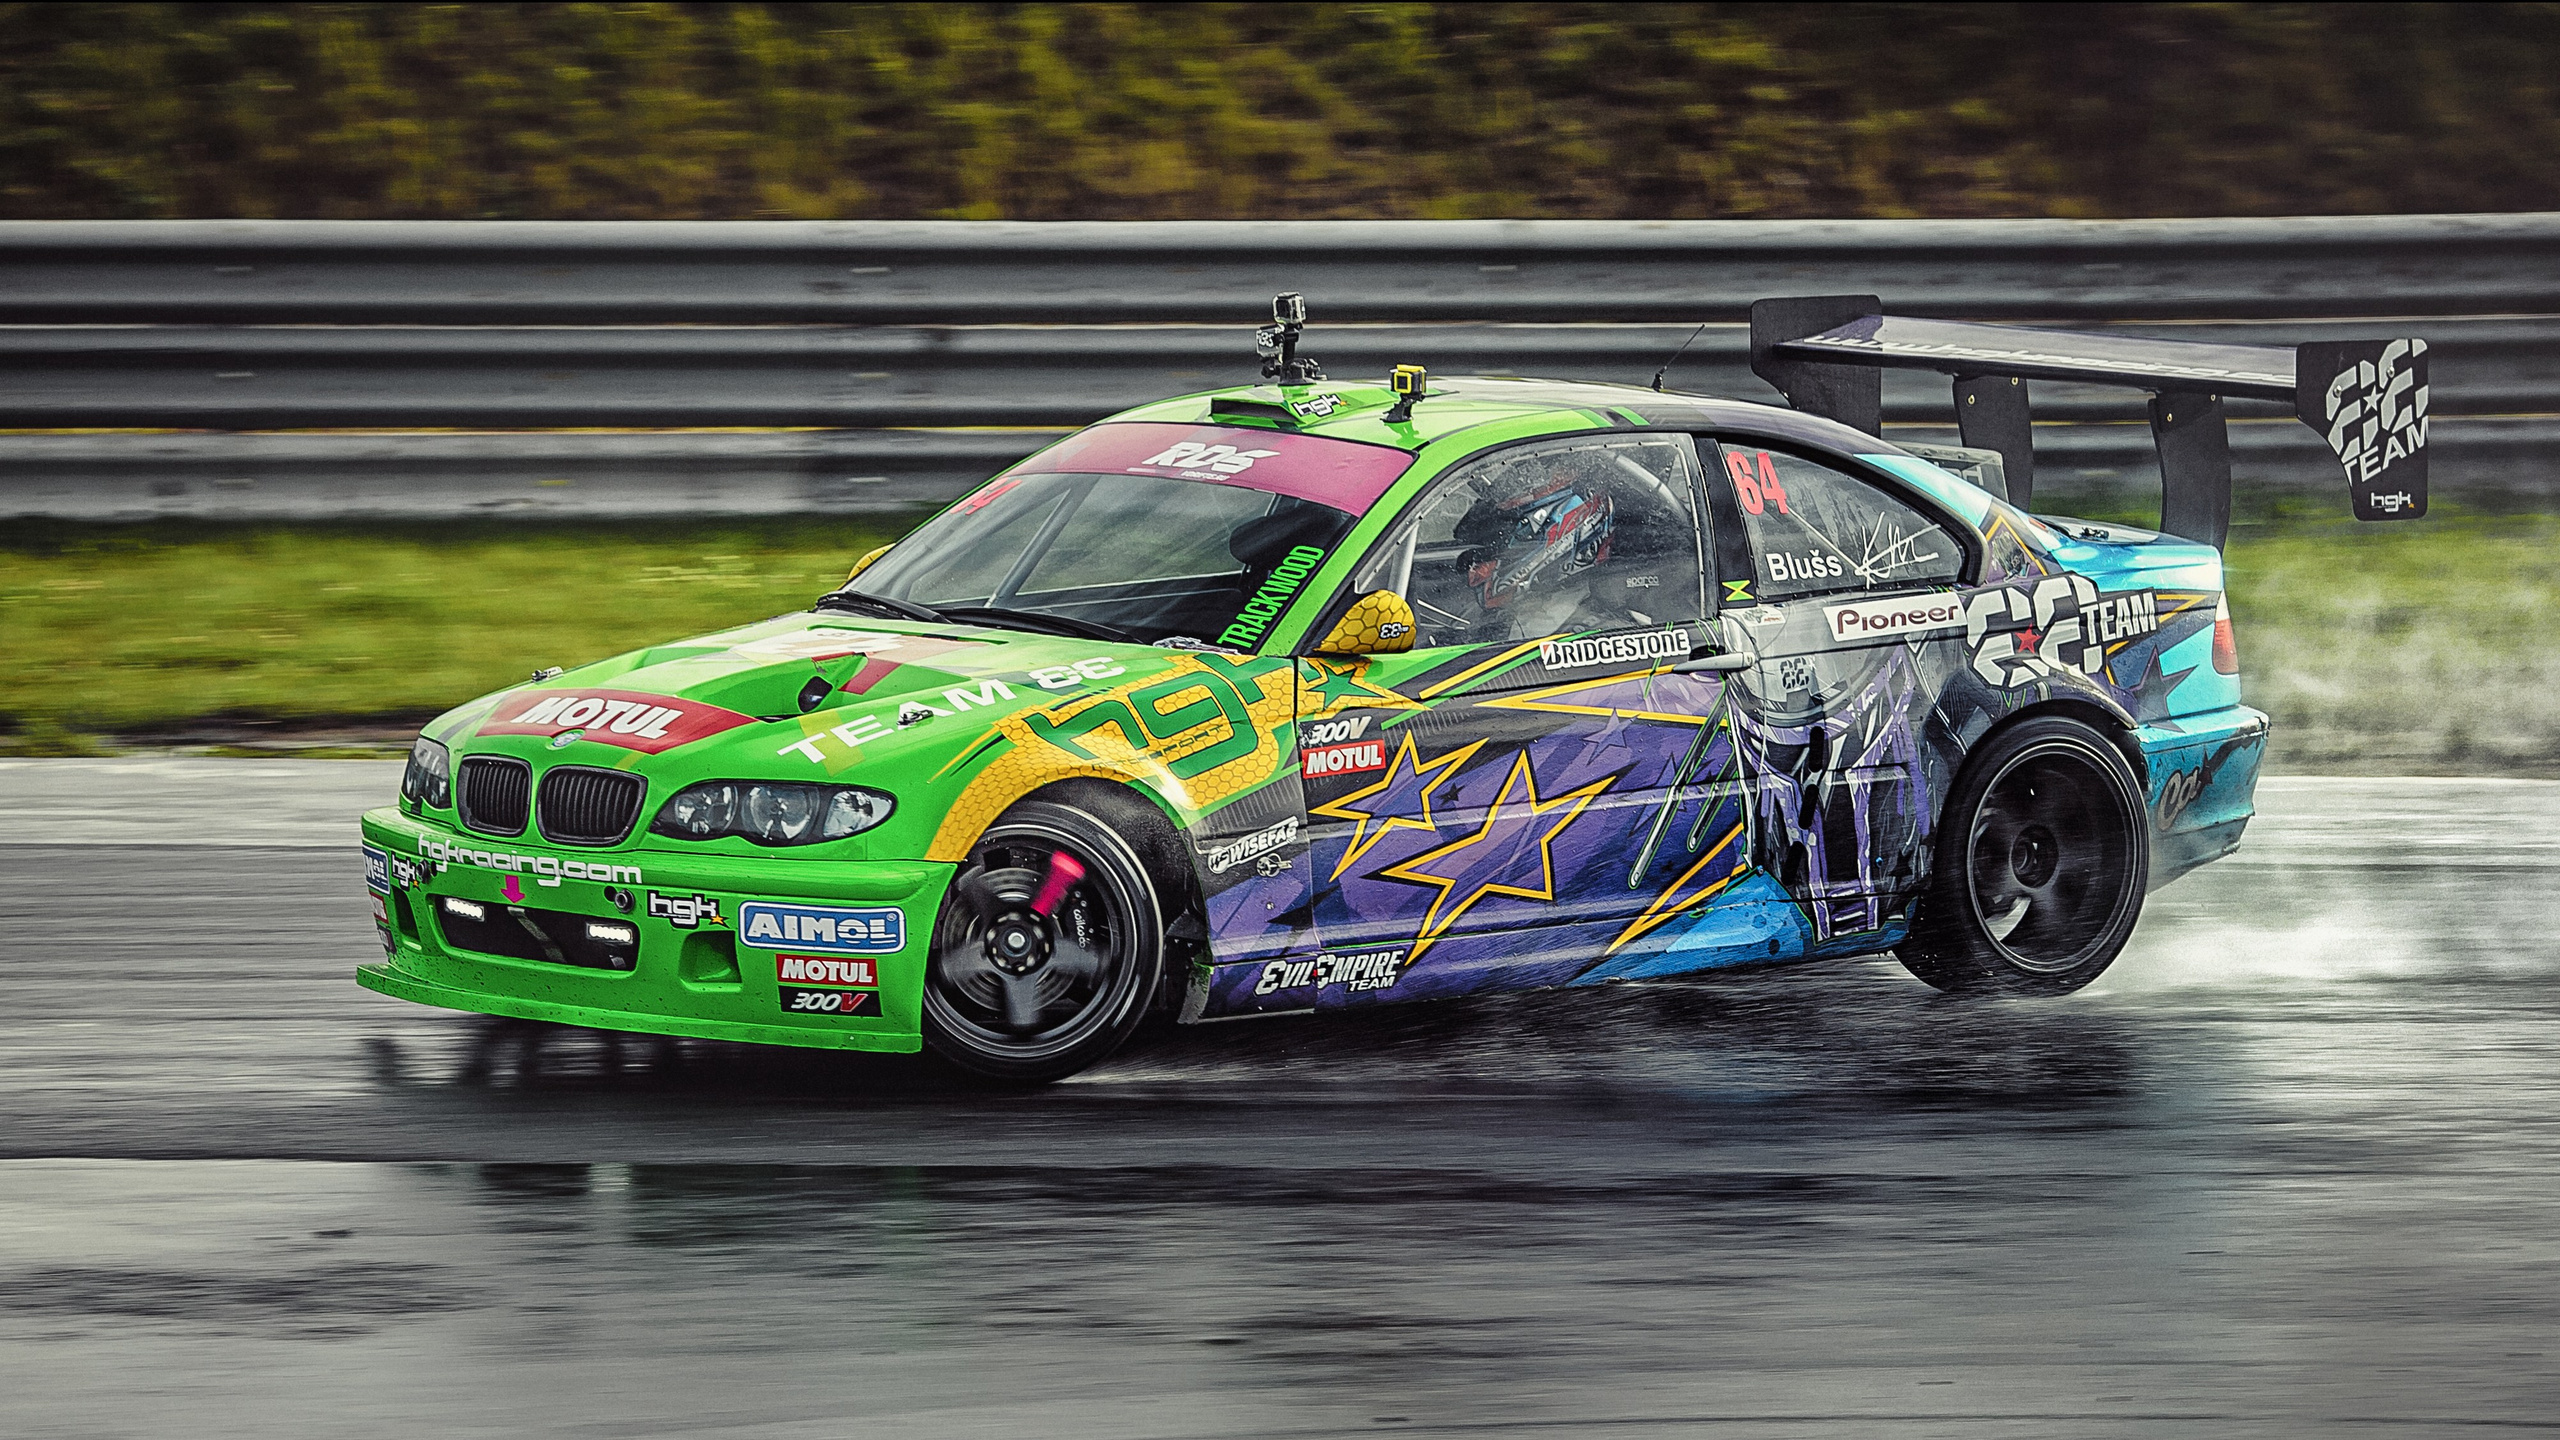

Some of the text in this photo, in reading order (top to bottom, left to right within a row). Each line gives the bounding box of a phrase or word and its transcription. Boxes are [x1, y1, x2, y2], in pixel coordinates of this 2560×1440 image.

[1293, 394, 1341, 416] hgk
[1141, 442, 1281, 474] RDS
[2344, 415, 2429, 487] TEAM
[1727, 452, 1788, 515] 64
[2371, 491, 2411, 512] hgk
[1766, 550, 1842, 581] Blušs
[1216, 545, 1325, 648] TRACKWOOD
[1837, 605, 1958, 634] Pioneer
[2079, 593, 2157, 645] TEAM
[1542, 632, 1689, 666] BRIDGESTONE
[510, 697, 684, 739] MOTUL
[777, 679, 1017, 764] TEAM
[1308, 716, 1372, 744] 300V
[1306, 744, 1382, 774] MOTUL
[1230, 821, 1299, 863] WISEFAB
[392, 854, 415, 886] hgk
[418, 833, 642, 887] hgkracing.com
[650, 893, 717, 925] hgk
[748, 913, 897, 943] AIMOL
[781, 959, 873, 983] MOTUL
[1317, 950, 1405, 989] EMPIRE
[1349, 976, 1396, 991] TEAM
[791, 993, 868, 1012] 300V
